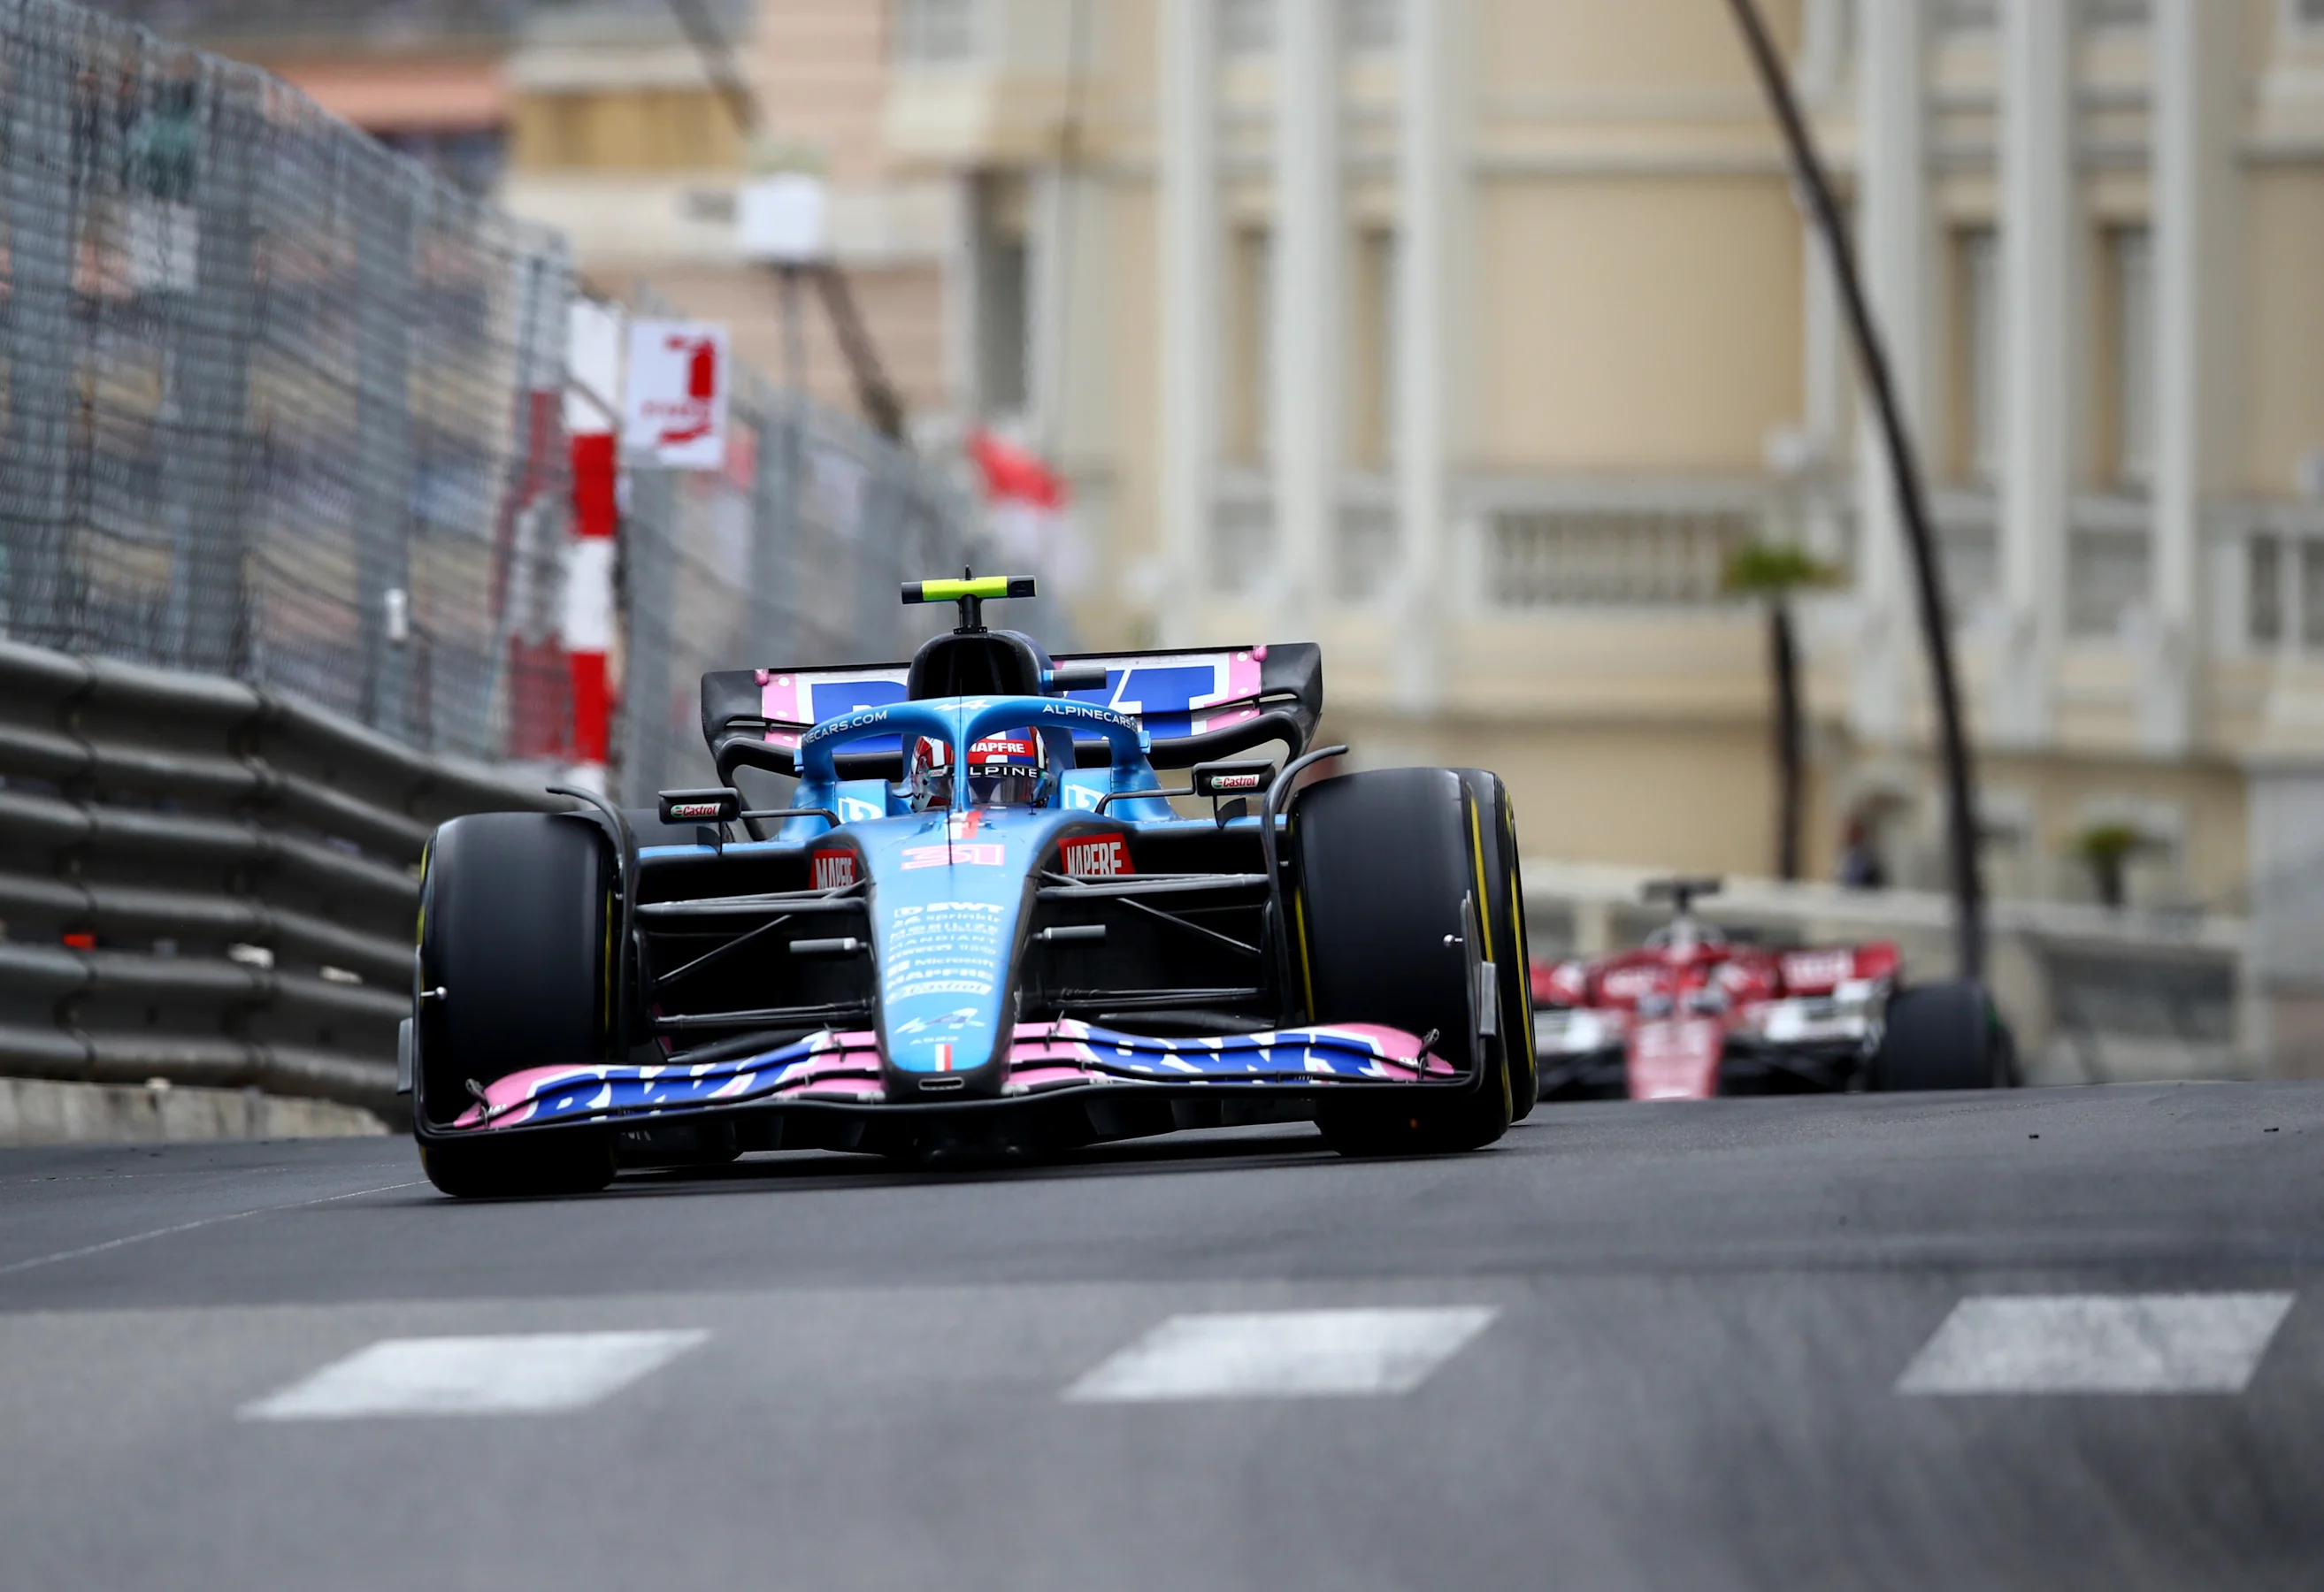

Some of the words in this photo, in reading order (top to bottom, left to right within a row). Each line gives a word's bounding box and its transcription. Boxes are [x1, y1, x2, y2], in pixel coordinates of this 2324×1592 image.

[967, 766, 1039, 778] LPINE
[1223, 777, 1256, 787] Castrol
[683, 806, 717, 816] Castrol
[901, 844, 1005, 870] 31
[926, 900, 1004, 914] BWT
[915, 957, 995, 968] Microsoft
